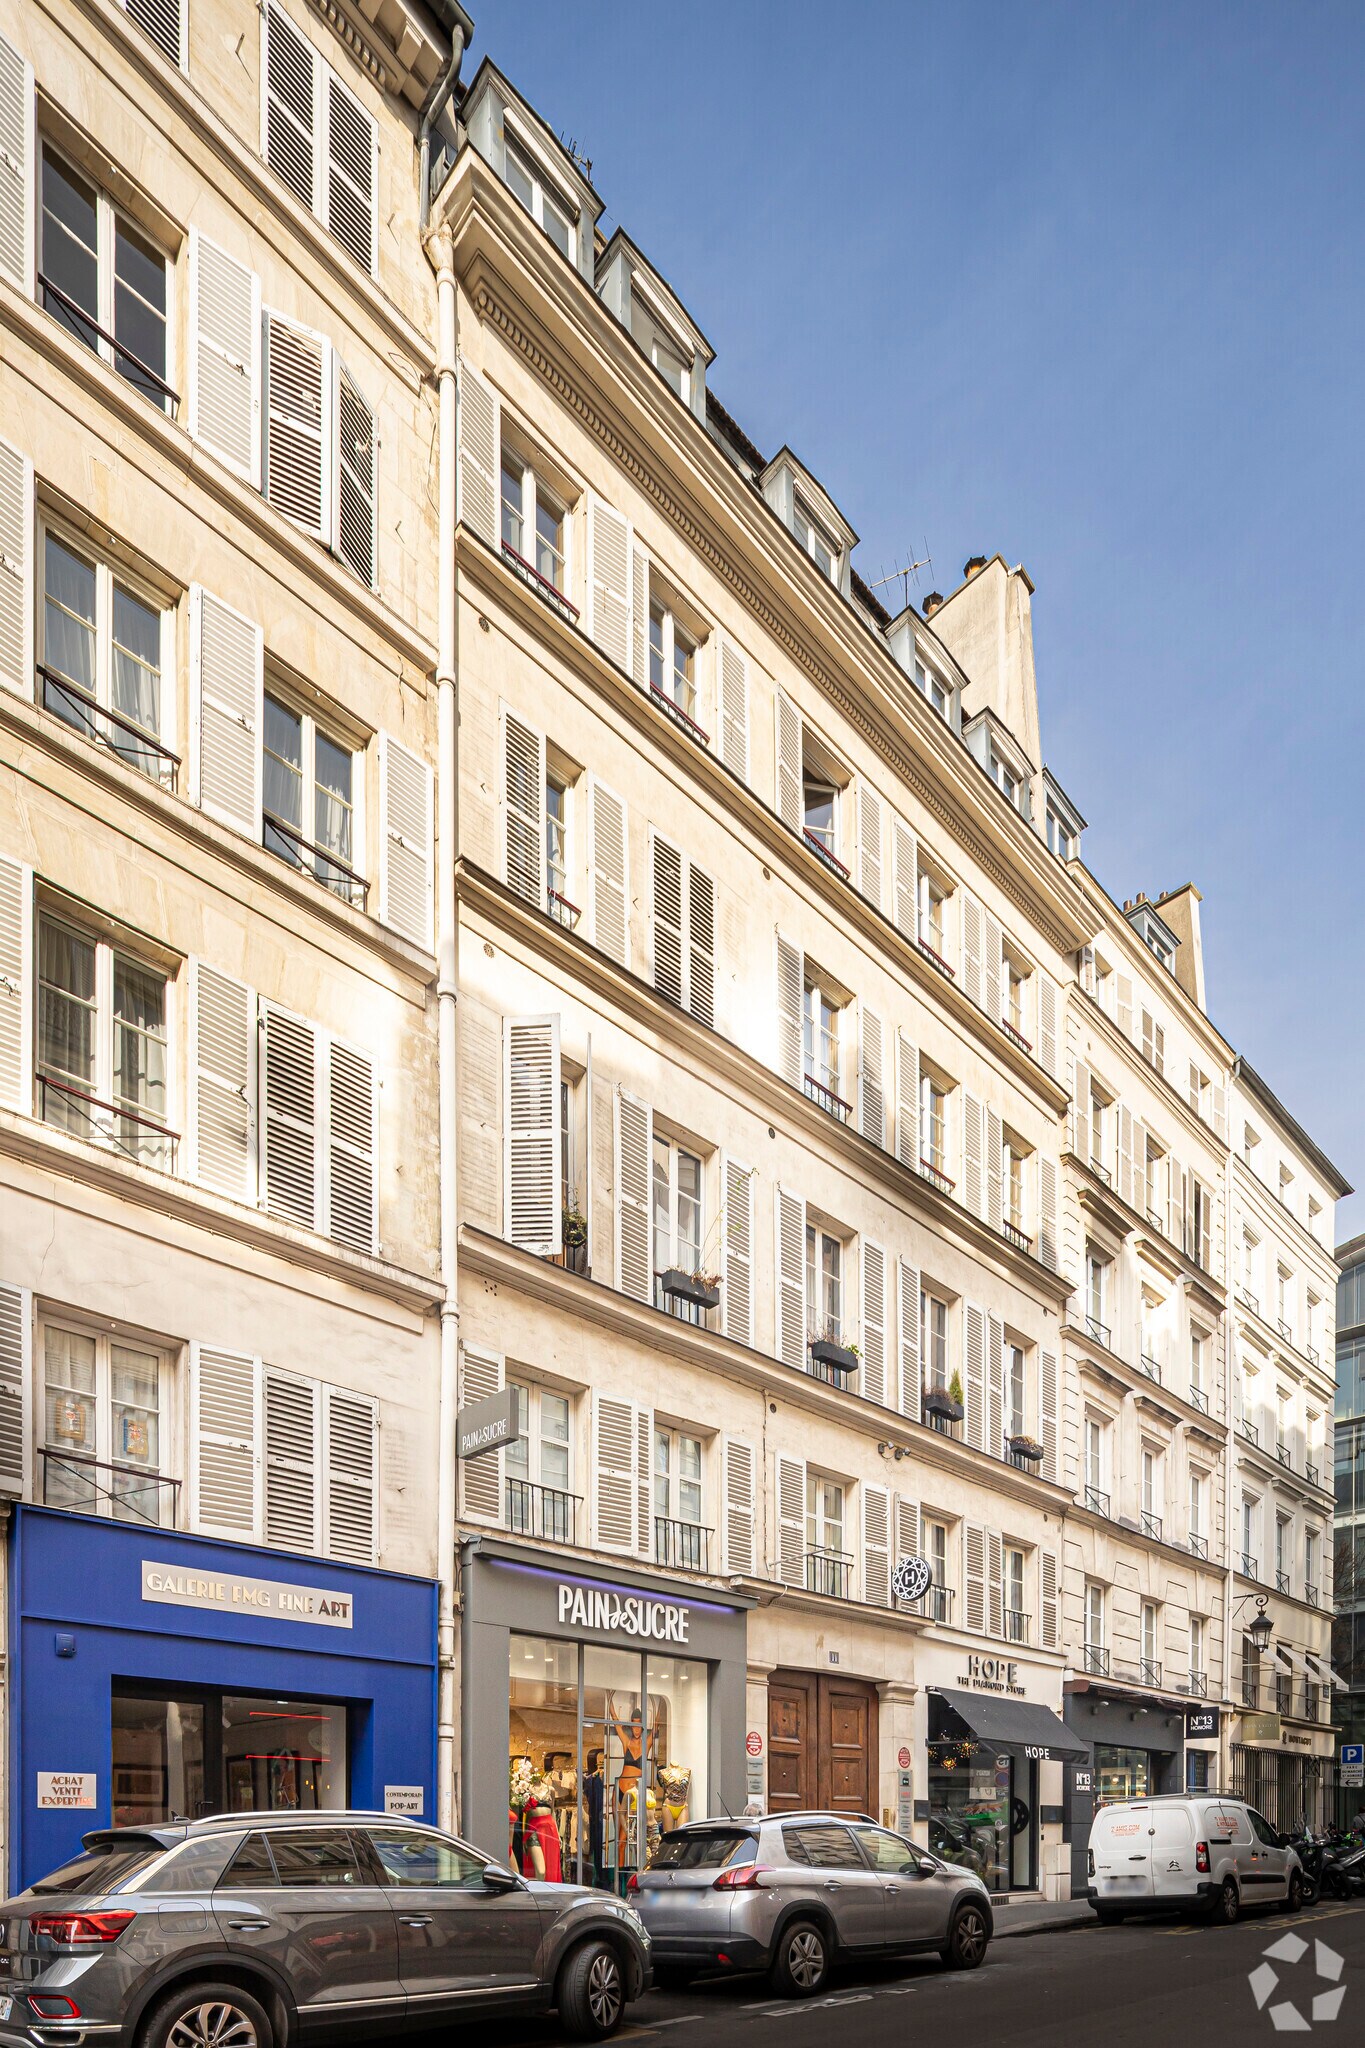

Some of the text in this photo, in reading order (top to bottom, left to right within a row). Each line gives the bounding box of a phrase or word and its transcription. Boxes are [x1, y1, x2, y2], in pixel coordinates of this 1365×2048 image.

[462, 1430, 480, 1451] PAIN
[483, 1419, 507, 1443] SUCRE
[904, 1570, 915, 1585] H
[146, 1573, 225, 1601] GALERIE
[278, 1592, 313, 1614] FINE
[318, 1599, 350, 1619] ART
[558, 1584, 610, 1630] PAIN
[624, 1597, 689, 1643] SUCRE
[968, 1654, 1018, 1684] HOPE
[972, 1678, 1005, 1693] DIAMOND
[1005, 1684, 1027, 1696] STORE
[1024, 1745, 1050, 1760] HOPE
[1347, 1748, 1357, 1761] P
[51, 1776, 84, 1785] ACHAT
[390, 1802, 419, 1810] POP-ART
